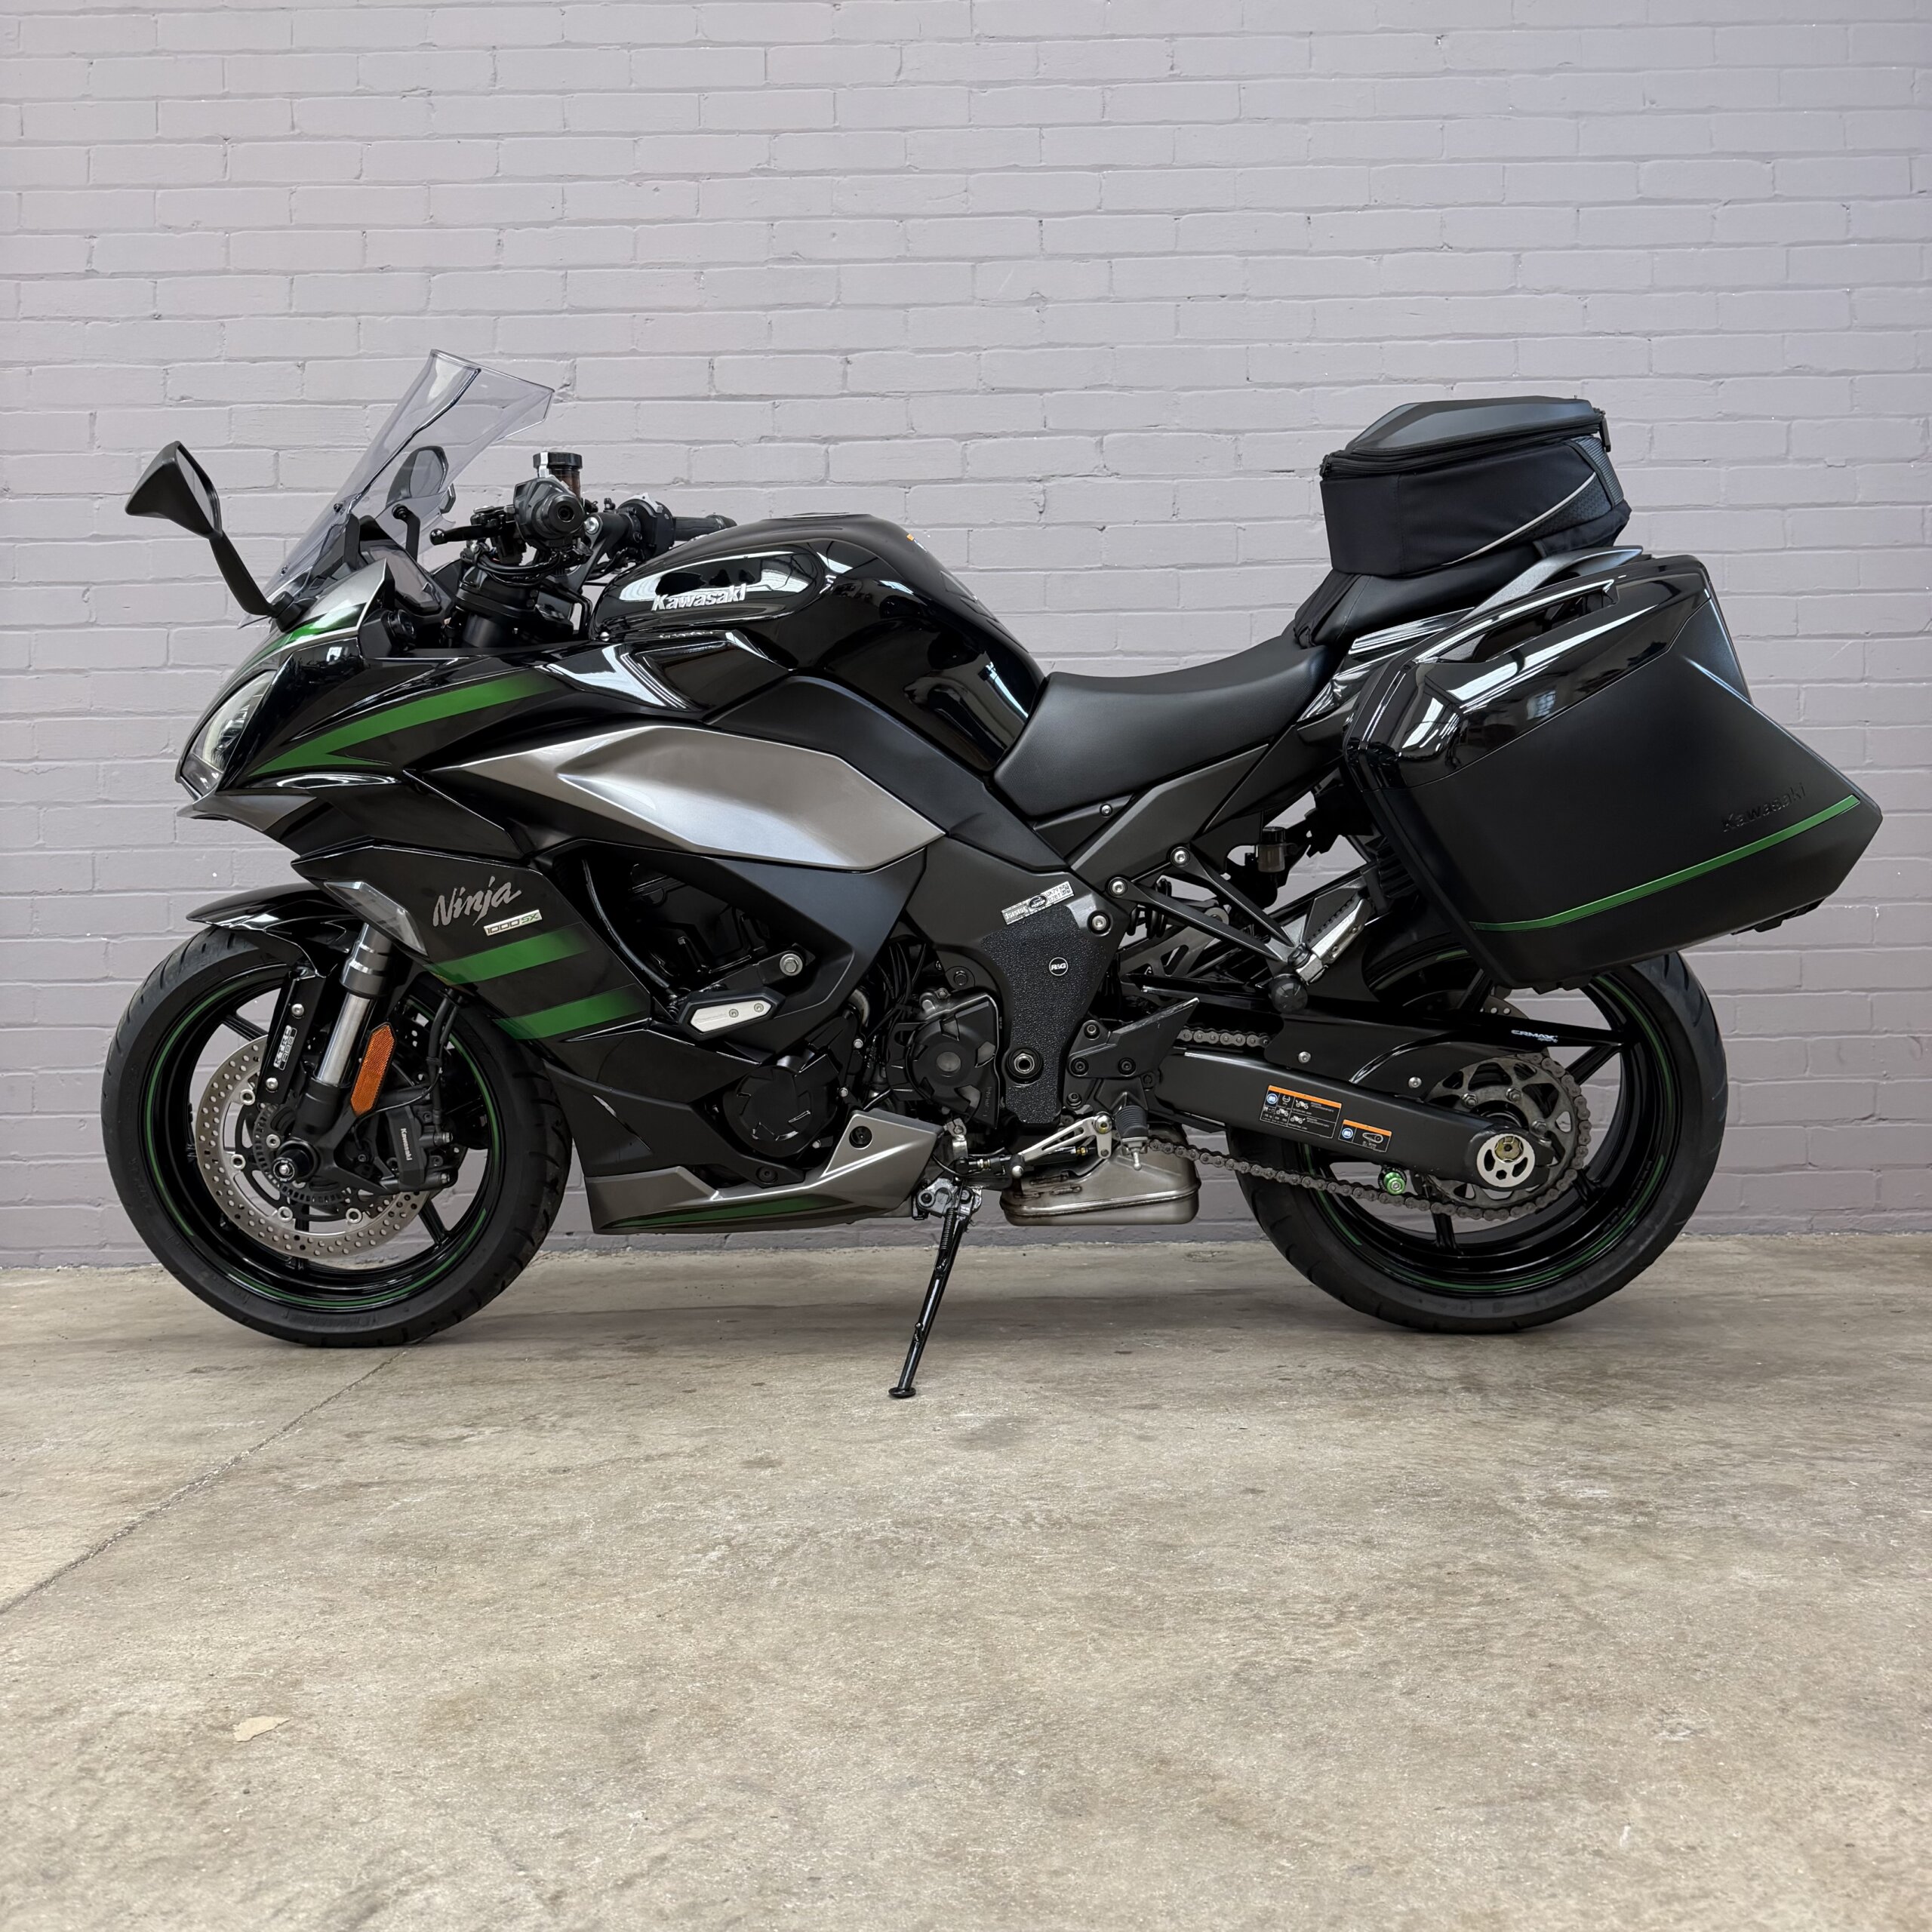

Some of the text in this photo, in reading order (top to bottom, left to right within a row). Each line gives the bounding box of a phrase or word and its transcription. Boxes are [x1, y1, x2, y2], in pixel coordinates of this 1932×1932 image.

[651, 583, 747, 611] Kawasaki
[1722, 782, 1806, 832] Kawasaki
[432, 875, 522, 927] Ninja
[401, 1128, 413, 1161] Kawasaki
